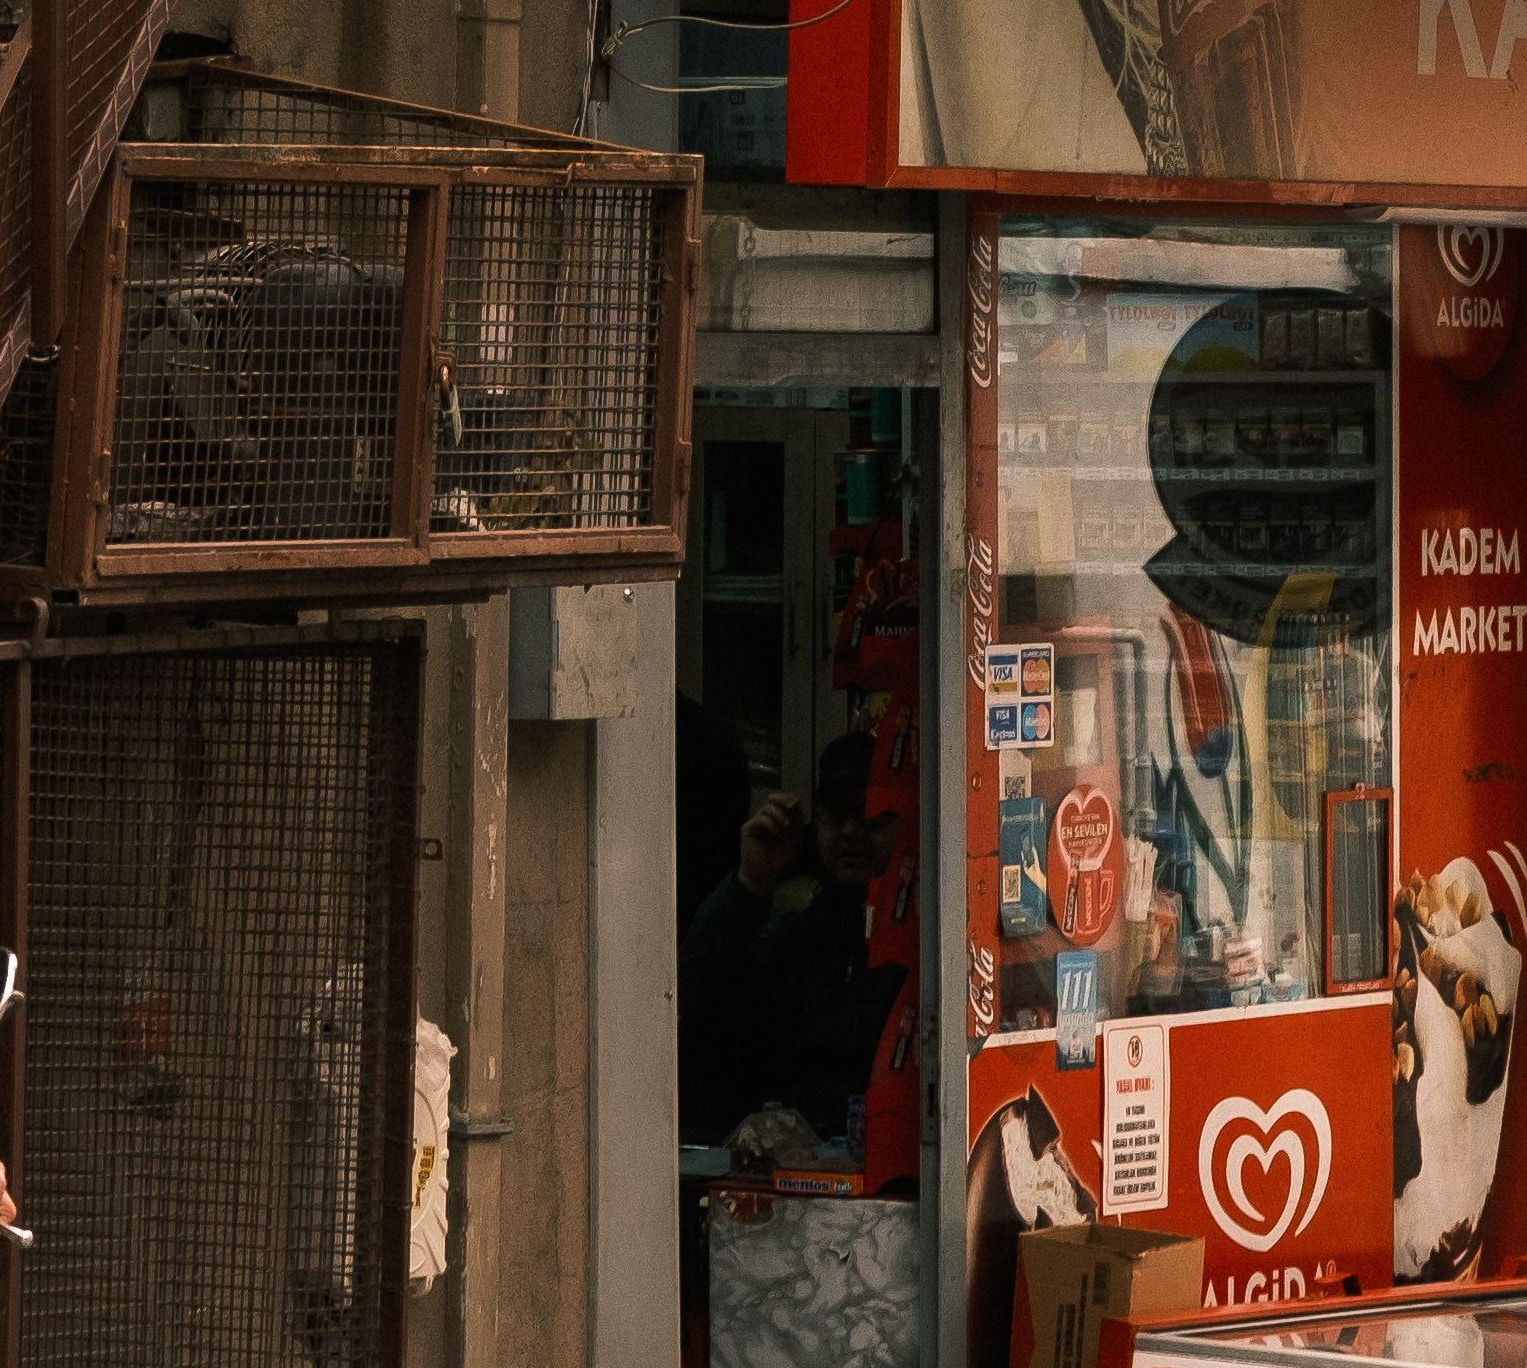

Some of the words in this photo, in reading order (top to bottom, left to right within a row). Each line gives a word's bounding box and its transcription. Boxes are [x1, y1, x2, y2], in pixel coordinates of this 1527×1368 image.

[1421, 526, 1521, 578] KADEM
[1412, 604, 1527, 656] MARKET
[993, 665, 1013, 681] VISA
